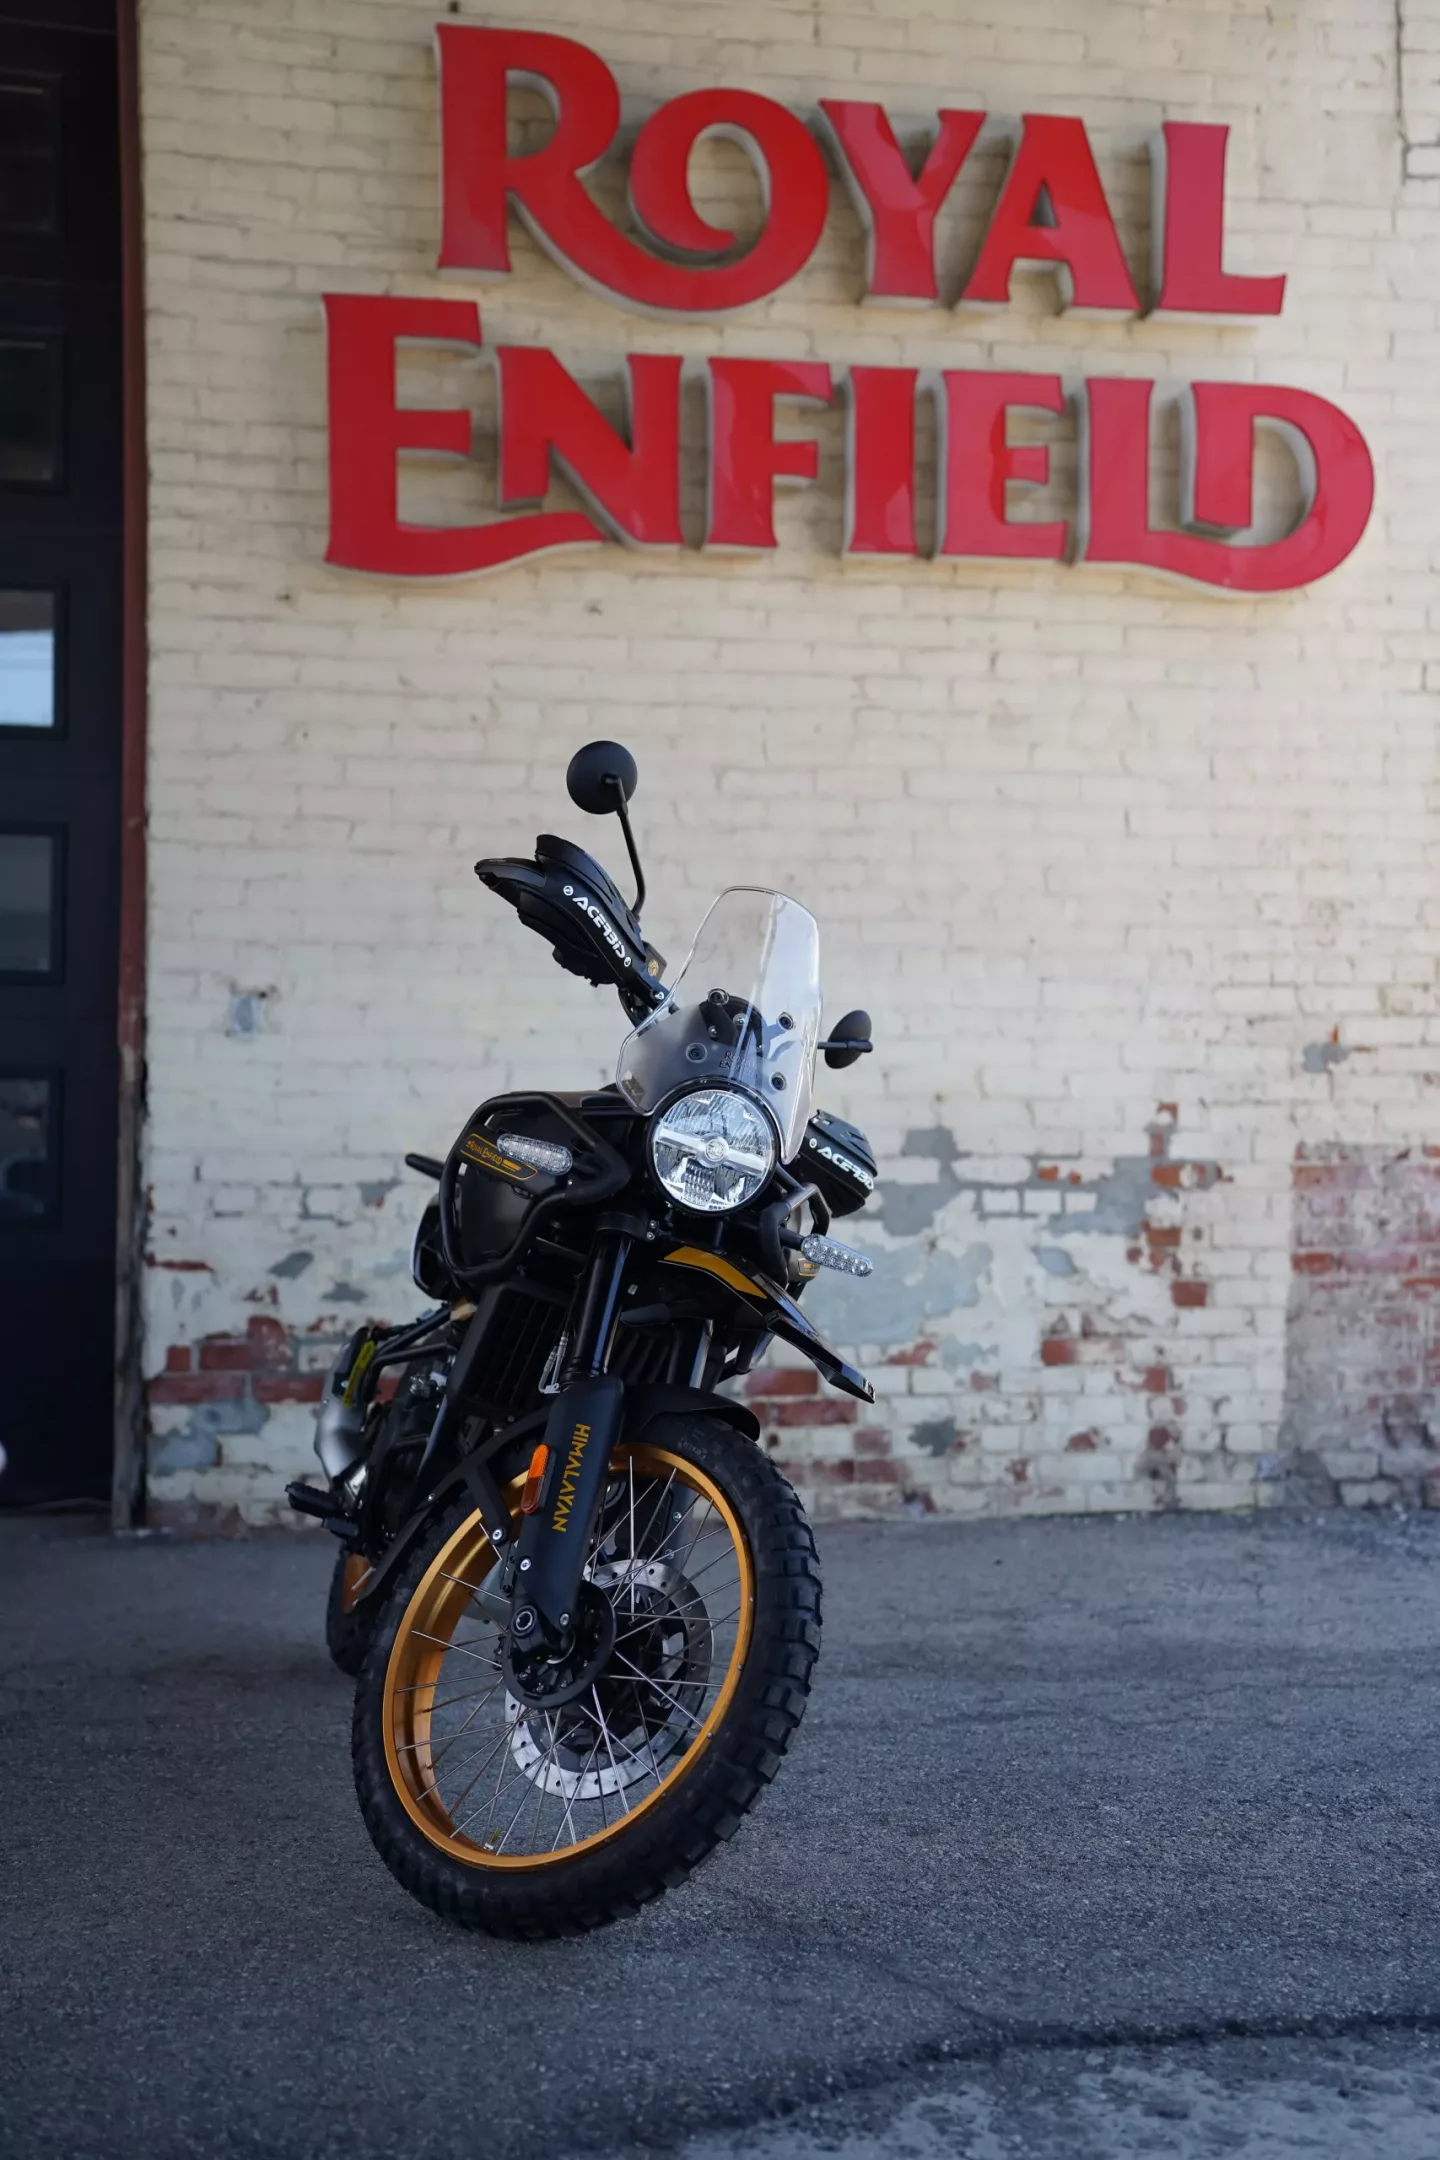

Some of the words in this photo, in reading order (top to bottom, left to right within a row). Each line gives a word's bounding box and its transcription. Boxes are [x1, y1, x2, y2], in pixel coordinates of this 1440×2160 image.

[434, 23, 1286, 319] ROYAL
[322, 293, 1375, 592] ENFIELD
[572, 897, 626, 958] ACERBIS
[551, 1423, 592, 1533] HIMALAYAN
